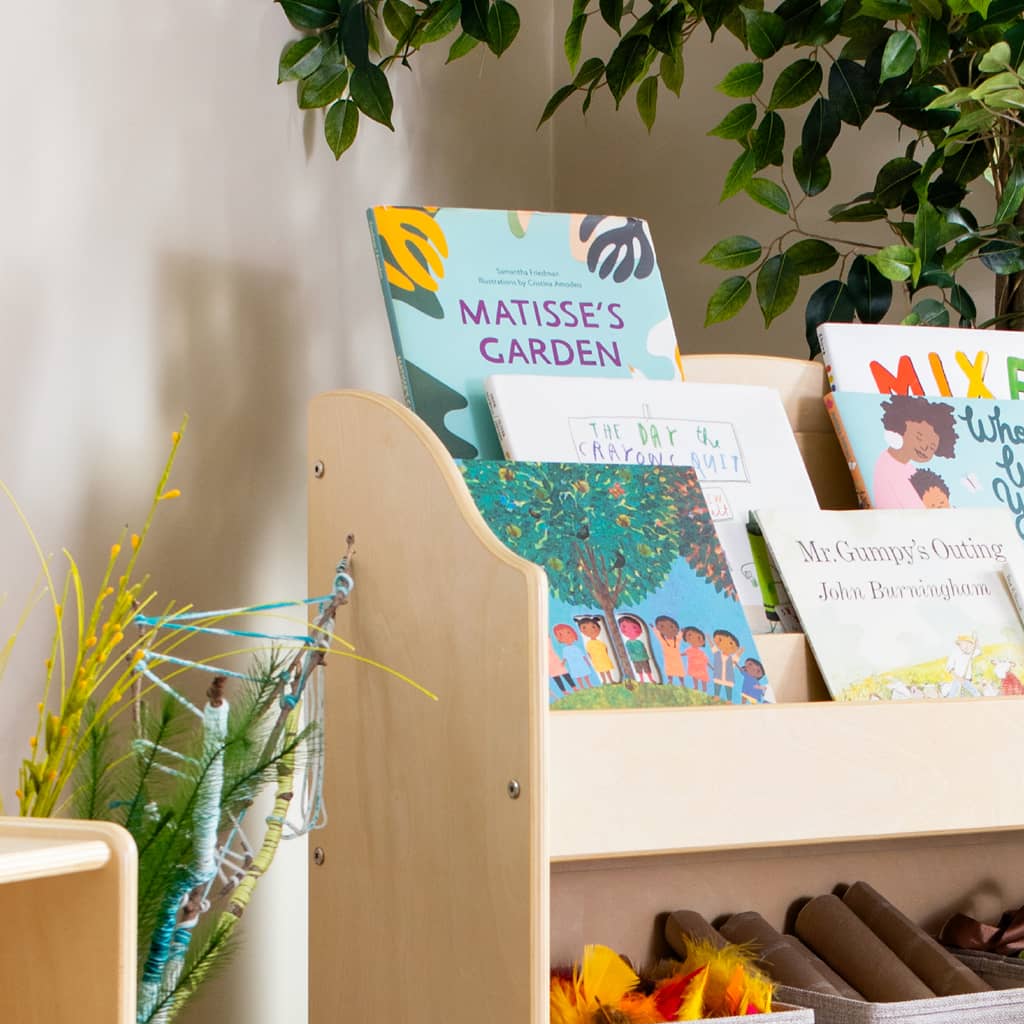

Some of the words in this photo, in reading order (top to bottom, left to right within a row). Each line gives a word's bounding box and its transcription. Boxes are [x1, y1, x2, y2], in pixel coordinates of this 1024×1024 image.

[518, 279, 526, 288] by
[458, 299, 625, 330] MATISSE'S
[479, 337, 622, 367] GARDEN
[589, 422, 620, 441] THE
[638, 422, 677, 448] DAY
[696, 425, 721, 448] the
[690, 452, 740, 479] QUIT
[931, 537, 1008, 562] Outing
[818, 581, 865, 601] John
[868, 578, 992, 601] Burningham
